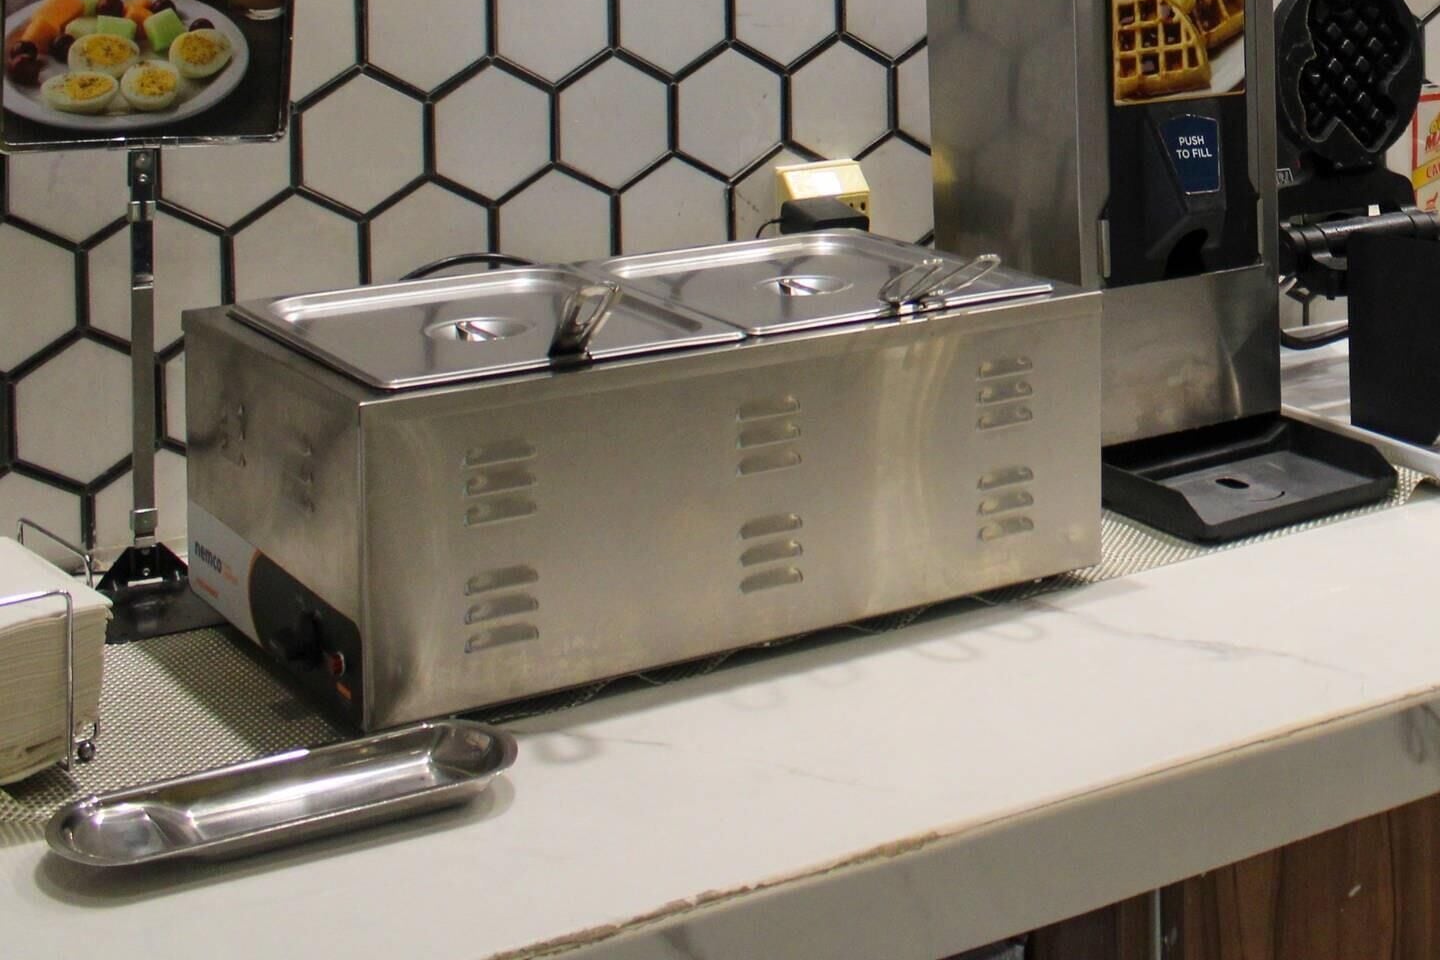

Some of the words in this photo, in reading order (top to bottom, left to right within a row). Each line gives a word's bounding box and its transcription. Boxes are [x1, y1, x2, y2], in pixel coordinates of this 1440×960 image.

[1178, 136, 1205, 147] PUSH
[1176, 149, 1190, 160] TO
[1192, 148, 1213, 158] FILL
[194, 541, 222, 574] nemco
